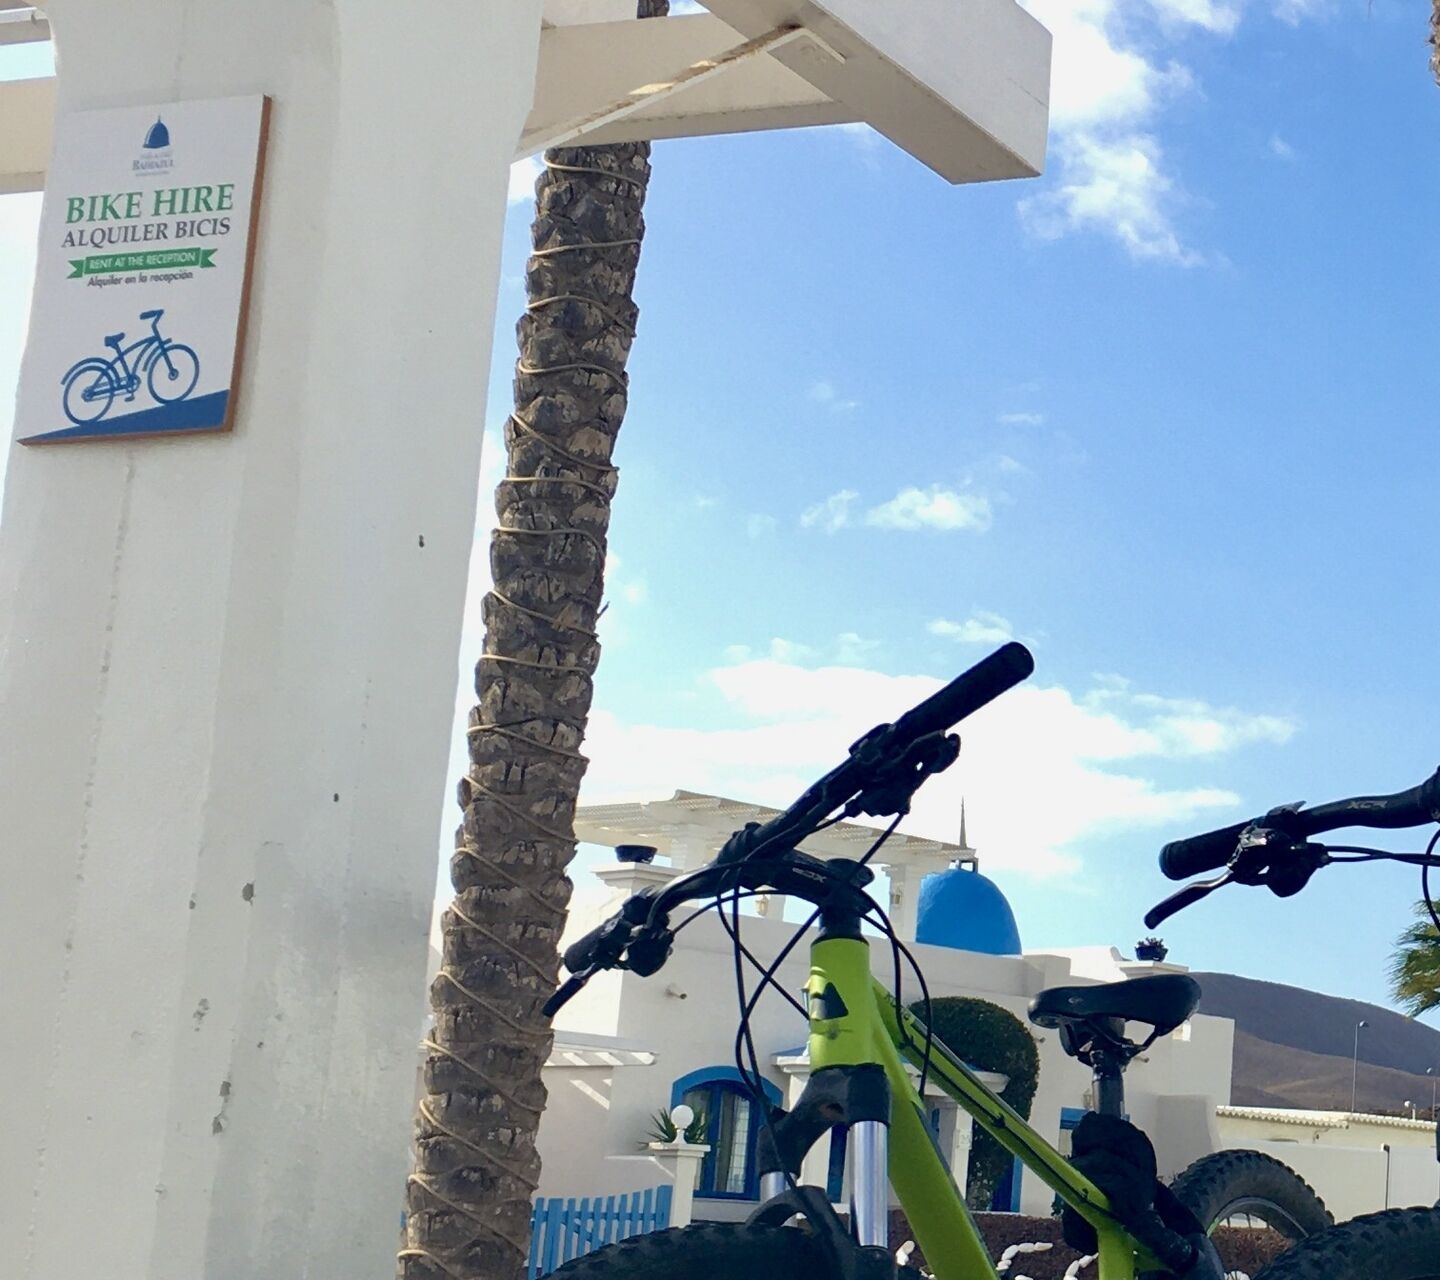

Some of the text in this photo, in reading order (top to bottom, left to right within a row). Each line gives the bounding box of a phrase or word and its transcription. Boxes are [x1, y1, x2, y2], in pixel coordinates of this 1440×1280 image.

[65, 183, 235, 224] BIKE HIRE
[61, 217, 231, 249] ALQUILER BICIS
[89, 252, 196, 269] RENT AT THE RECEPTION
[87, 273, 123, 288] Alquiler
[124, 276, 137, 284] en
[139, 272, 148, 283] la
